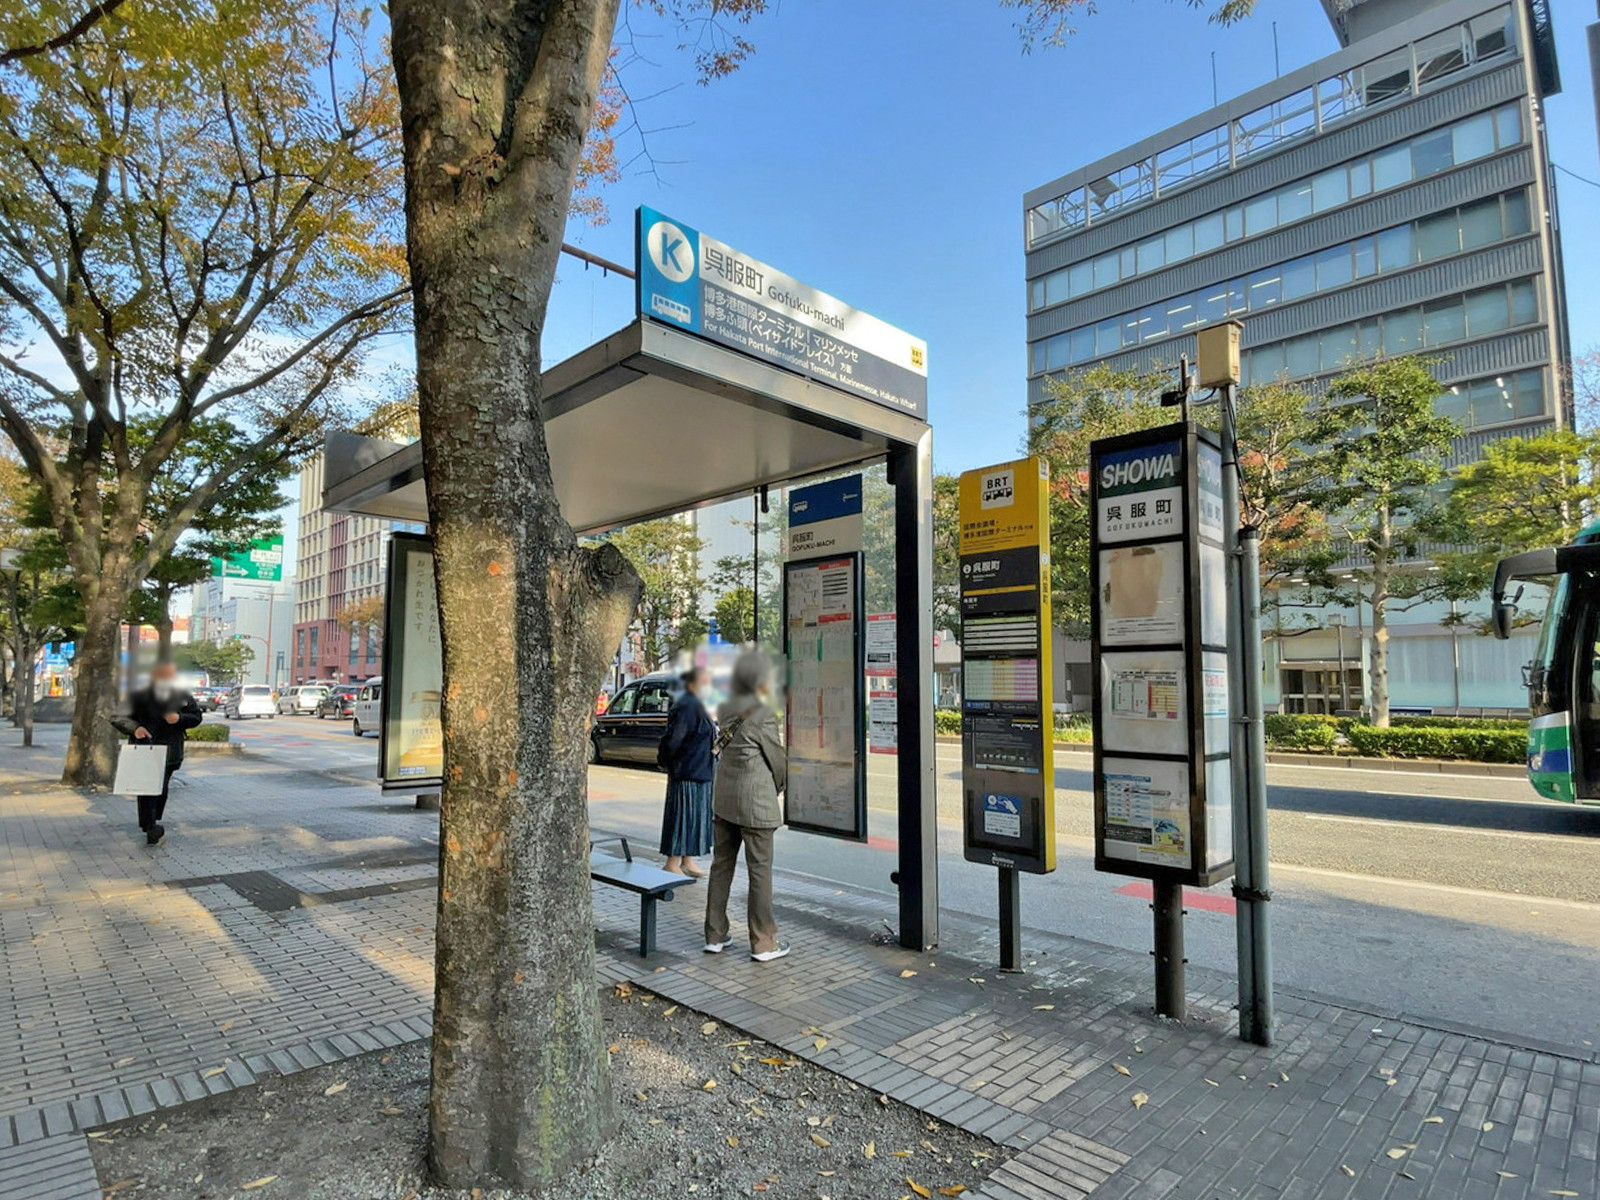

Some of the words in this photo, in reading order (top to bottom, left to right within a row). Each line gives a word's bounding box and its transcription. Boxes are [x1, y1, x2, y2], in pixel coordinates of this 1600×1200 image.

[662, 232, 683, 274] K
[704, 246, 764, 295] 呉服町
[768, 285, 845, 331] Gofuku-machi
[748, 337, 765, 353] Port
[987, 476, 1008, 489] BRT
[1101, 453, 1175, 489] SHOWA
[1106, 499, 1173, 522] 呉服町
